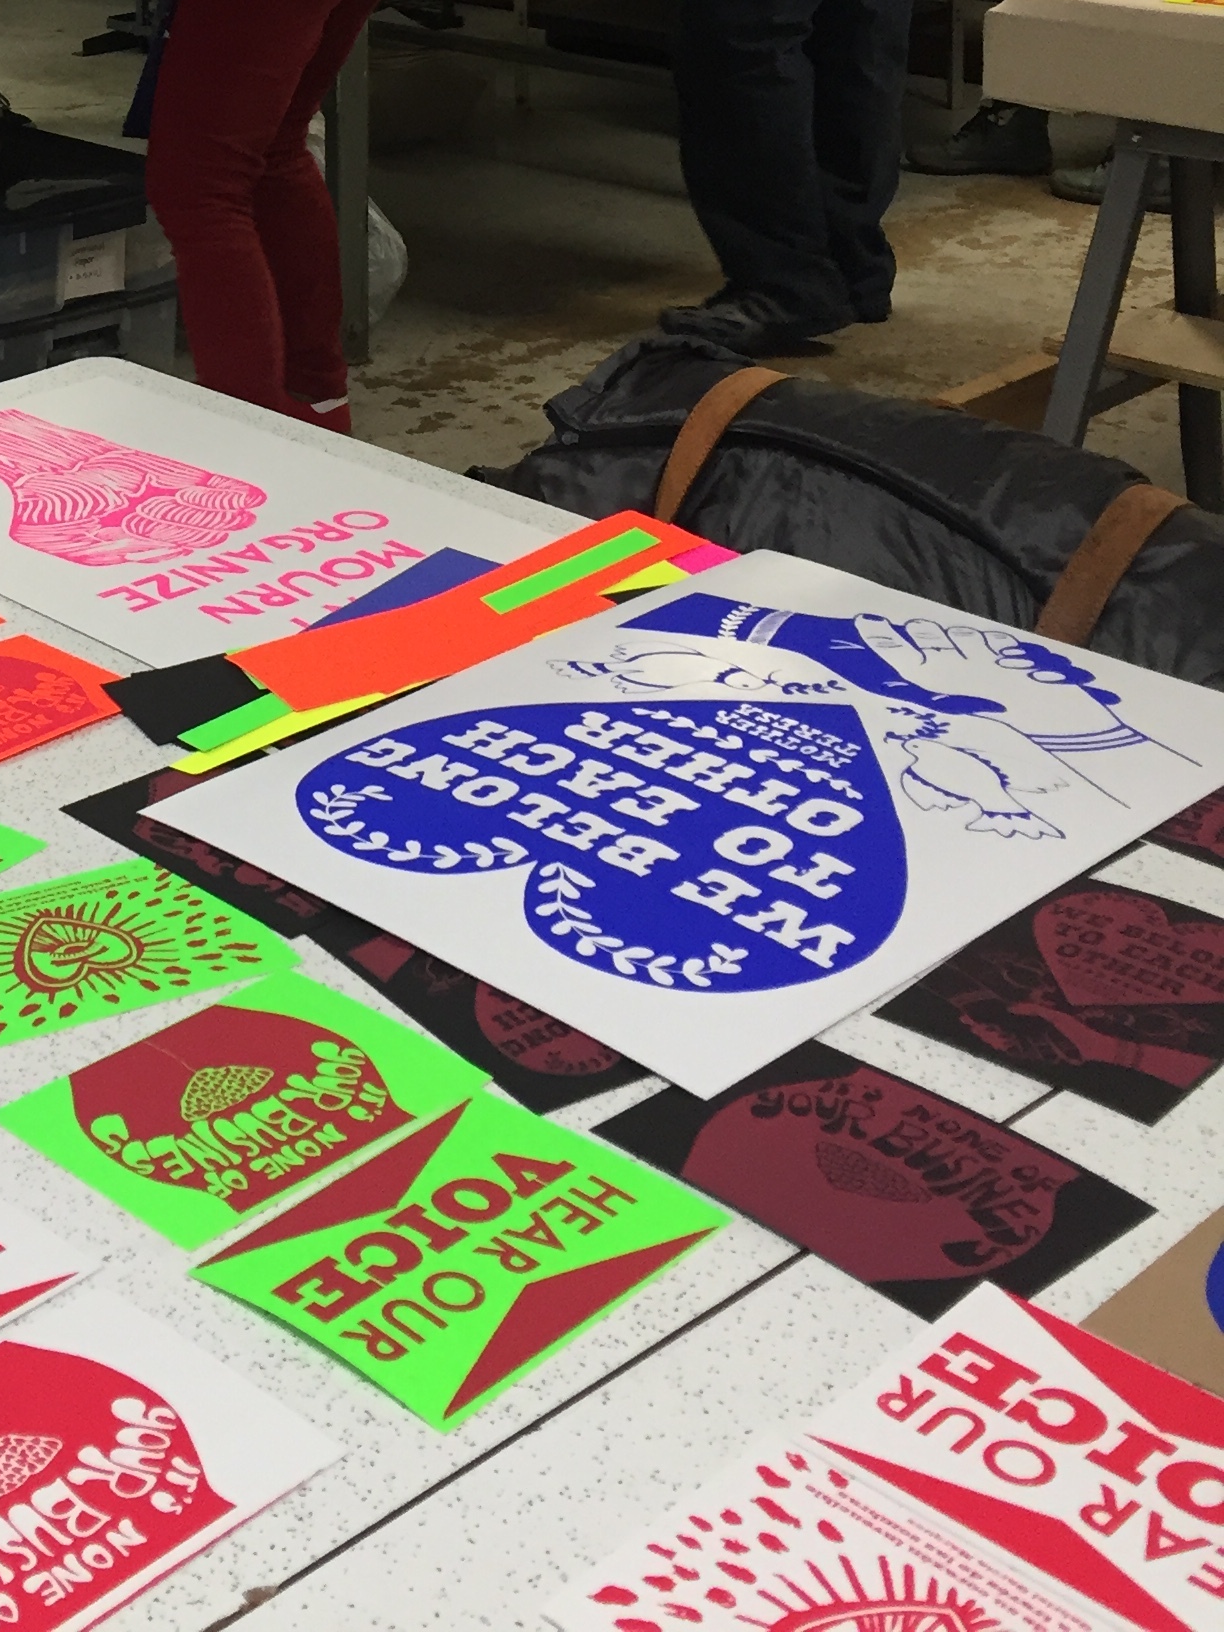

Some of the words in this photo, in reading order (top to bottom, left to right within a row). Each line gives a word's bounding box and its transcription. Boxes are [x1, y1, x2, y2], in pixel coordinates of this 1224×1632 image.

[96, 510, 389, 613] ORGANIZE
[199, 538, 427, 625] MOURN
[441, 719, 703, 830] EACH
[564, 710, 866, 838] OTHER
[715, 709, 852, 768] MOTHER
[734, 703, 861, 757] TERESA
[345, 737, 682, 879] BELONG
[713, 825, 859, 900] TO
[671, 868, 859, 969] WE
[279, 1041, 367, 1112] YOUR
[90, 1095, 318, 1181] BUSINESS
[204, 1170, 248, 1199] OF
[249, 1123, 348, 1181] NONE
[901, 1104, 1015, 1165] NONE
[1009, 1163, 1062, 1193] OF
[271, 1152, 577, 1324] VOICE
[471, 1174, 638, 1275] HEAR
[872, 1119, 1043, 1268] BUSINESS
[339, 1271, 487, 1362] OUR
[68, 1396, 178, 1499] YOUR
[876, 1373, 1057, 1487] OUR
[917, 1330, 1224, 1526] OICE
[22, 1519, 148, 1607] NONE
